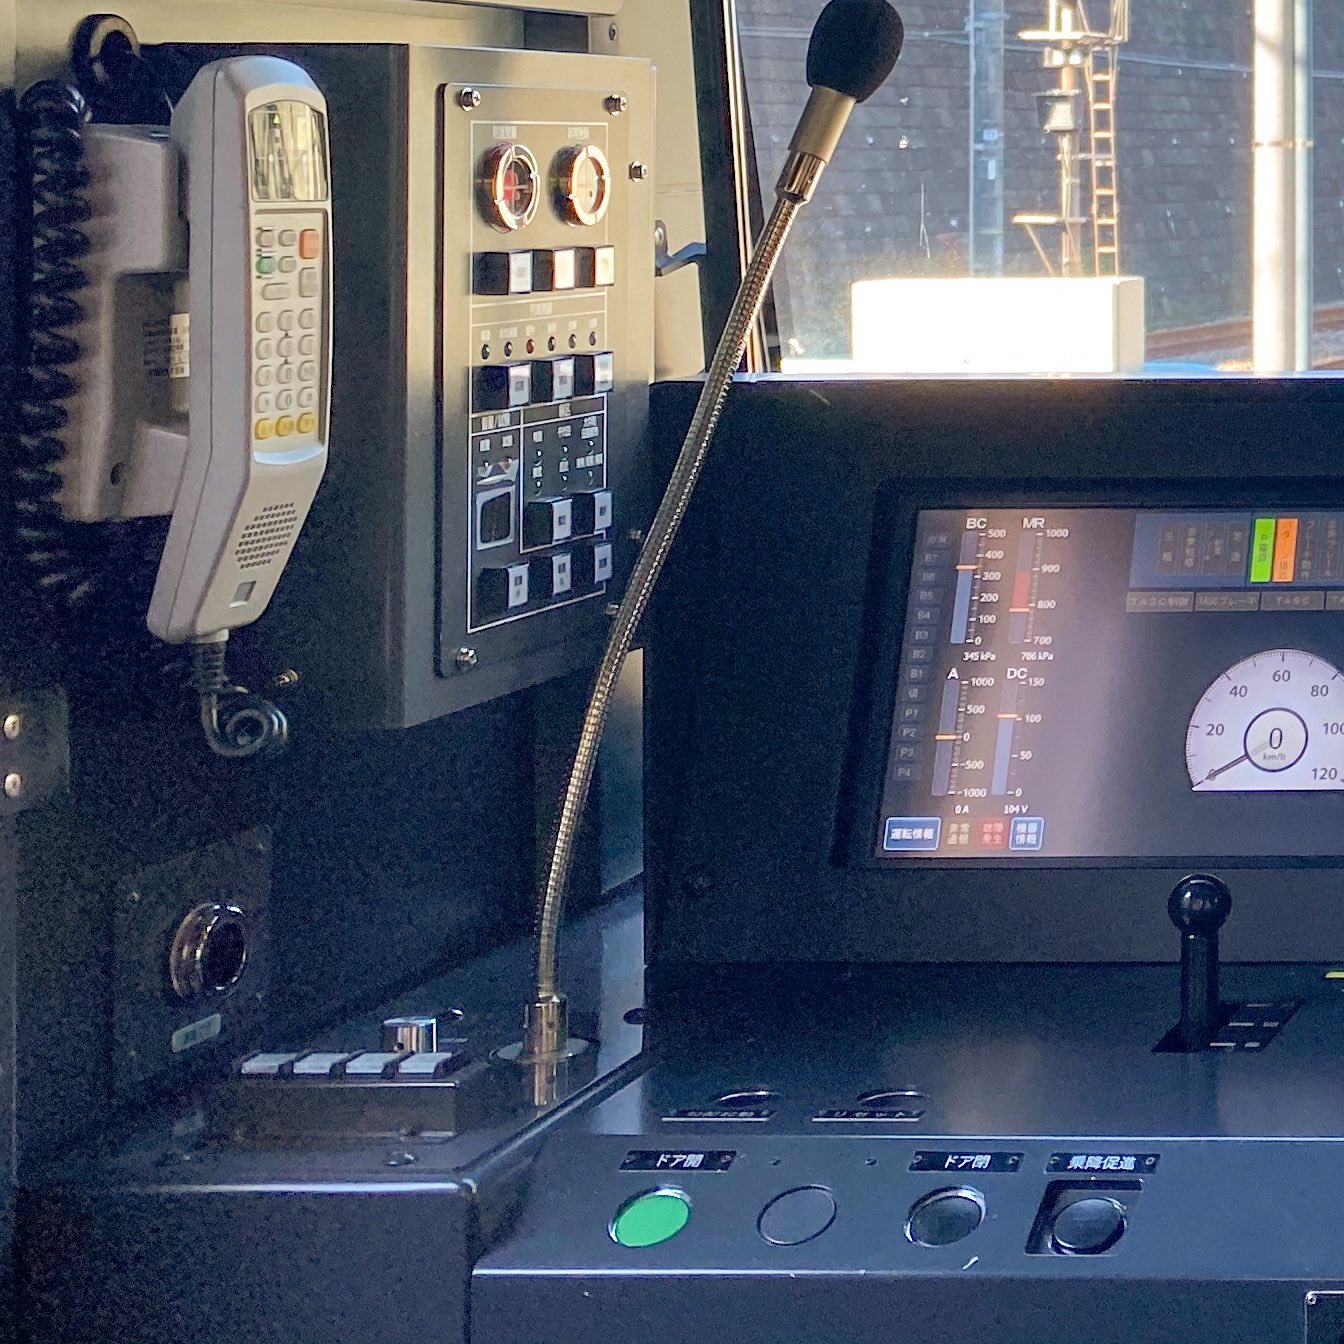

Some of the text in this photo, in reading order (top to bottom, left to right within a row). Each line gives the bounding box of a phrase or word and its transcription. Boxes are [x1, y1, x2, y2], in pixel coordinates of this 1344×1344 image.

[966, 518, 987, 529] BC
[1023, 518, 1045, 528] MR
[987, 529, 1006, 538] 500
[1046, 529, 1068, 537] 1000
[985, 551, 1003, 559] 400
[1041, 565, 1060, 573] 900
[982, 572, 1001, 580] 300
[980, 593, 998, 602] 200
[1037, 600, 1056, 608] 800
[979, 615, 996, 623] 100
[1034, 636, 1052, 645] 700
[947, 668, 958, 679] A
[1007, 669, 1028, 679] DC
[1272, 670, 1290, 682] 60
[971, 678, 994, 687] 1000
[1028, 678, 1044, 687] 150
[1229, 685, 1248, 697] 40
[1311, 685, 1328, 696] 80
[966, 705, 985, 714] 500
[1026, 714, 1041, 723] 100
[1206, 724, 1224, 736] 20
[1270, 728, 1282, 749] 0
[1020, 751, 1032, 760] 50
[1312, 768, 1337, 780] 120
[891, 829, 934, 840] 運転情報
[1016, 835, 1037, 844] 情報
[656, 1154, 704, 1167] ドア開
[944, 1155, 991, 1169] ドア閉
[1068, 1155, 1136, 1170] 乗降促進
